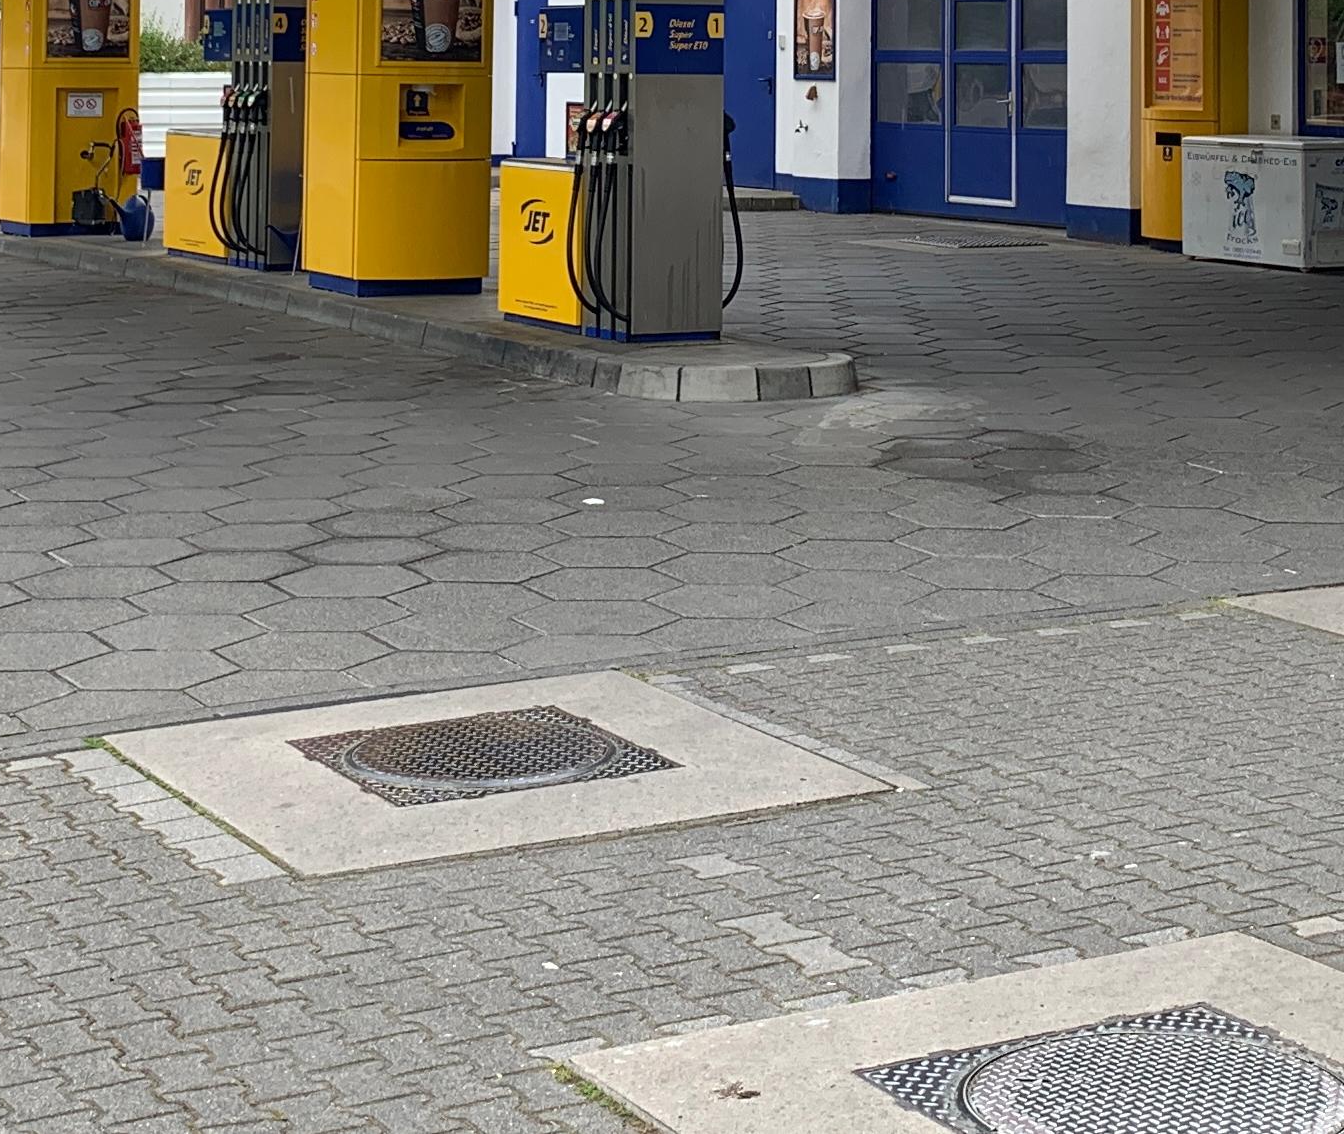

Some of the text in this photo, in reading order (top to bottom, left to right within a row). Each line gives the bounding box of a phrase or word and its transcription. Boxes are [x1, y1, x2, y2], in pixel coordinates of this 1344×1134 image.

[275, 17, 284, 30] 4
[540, 20, 546, 33] 2
[639, 17, 648, 32] 2
[669, 19, 695, 29] Diesel
[713, 18, 719, 33] 1
[669, 40, 692, 51] Super
[186, 169, 201, 186] JET
[524, 210, 550, 234] JET
